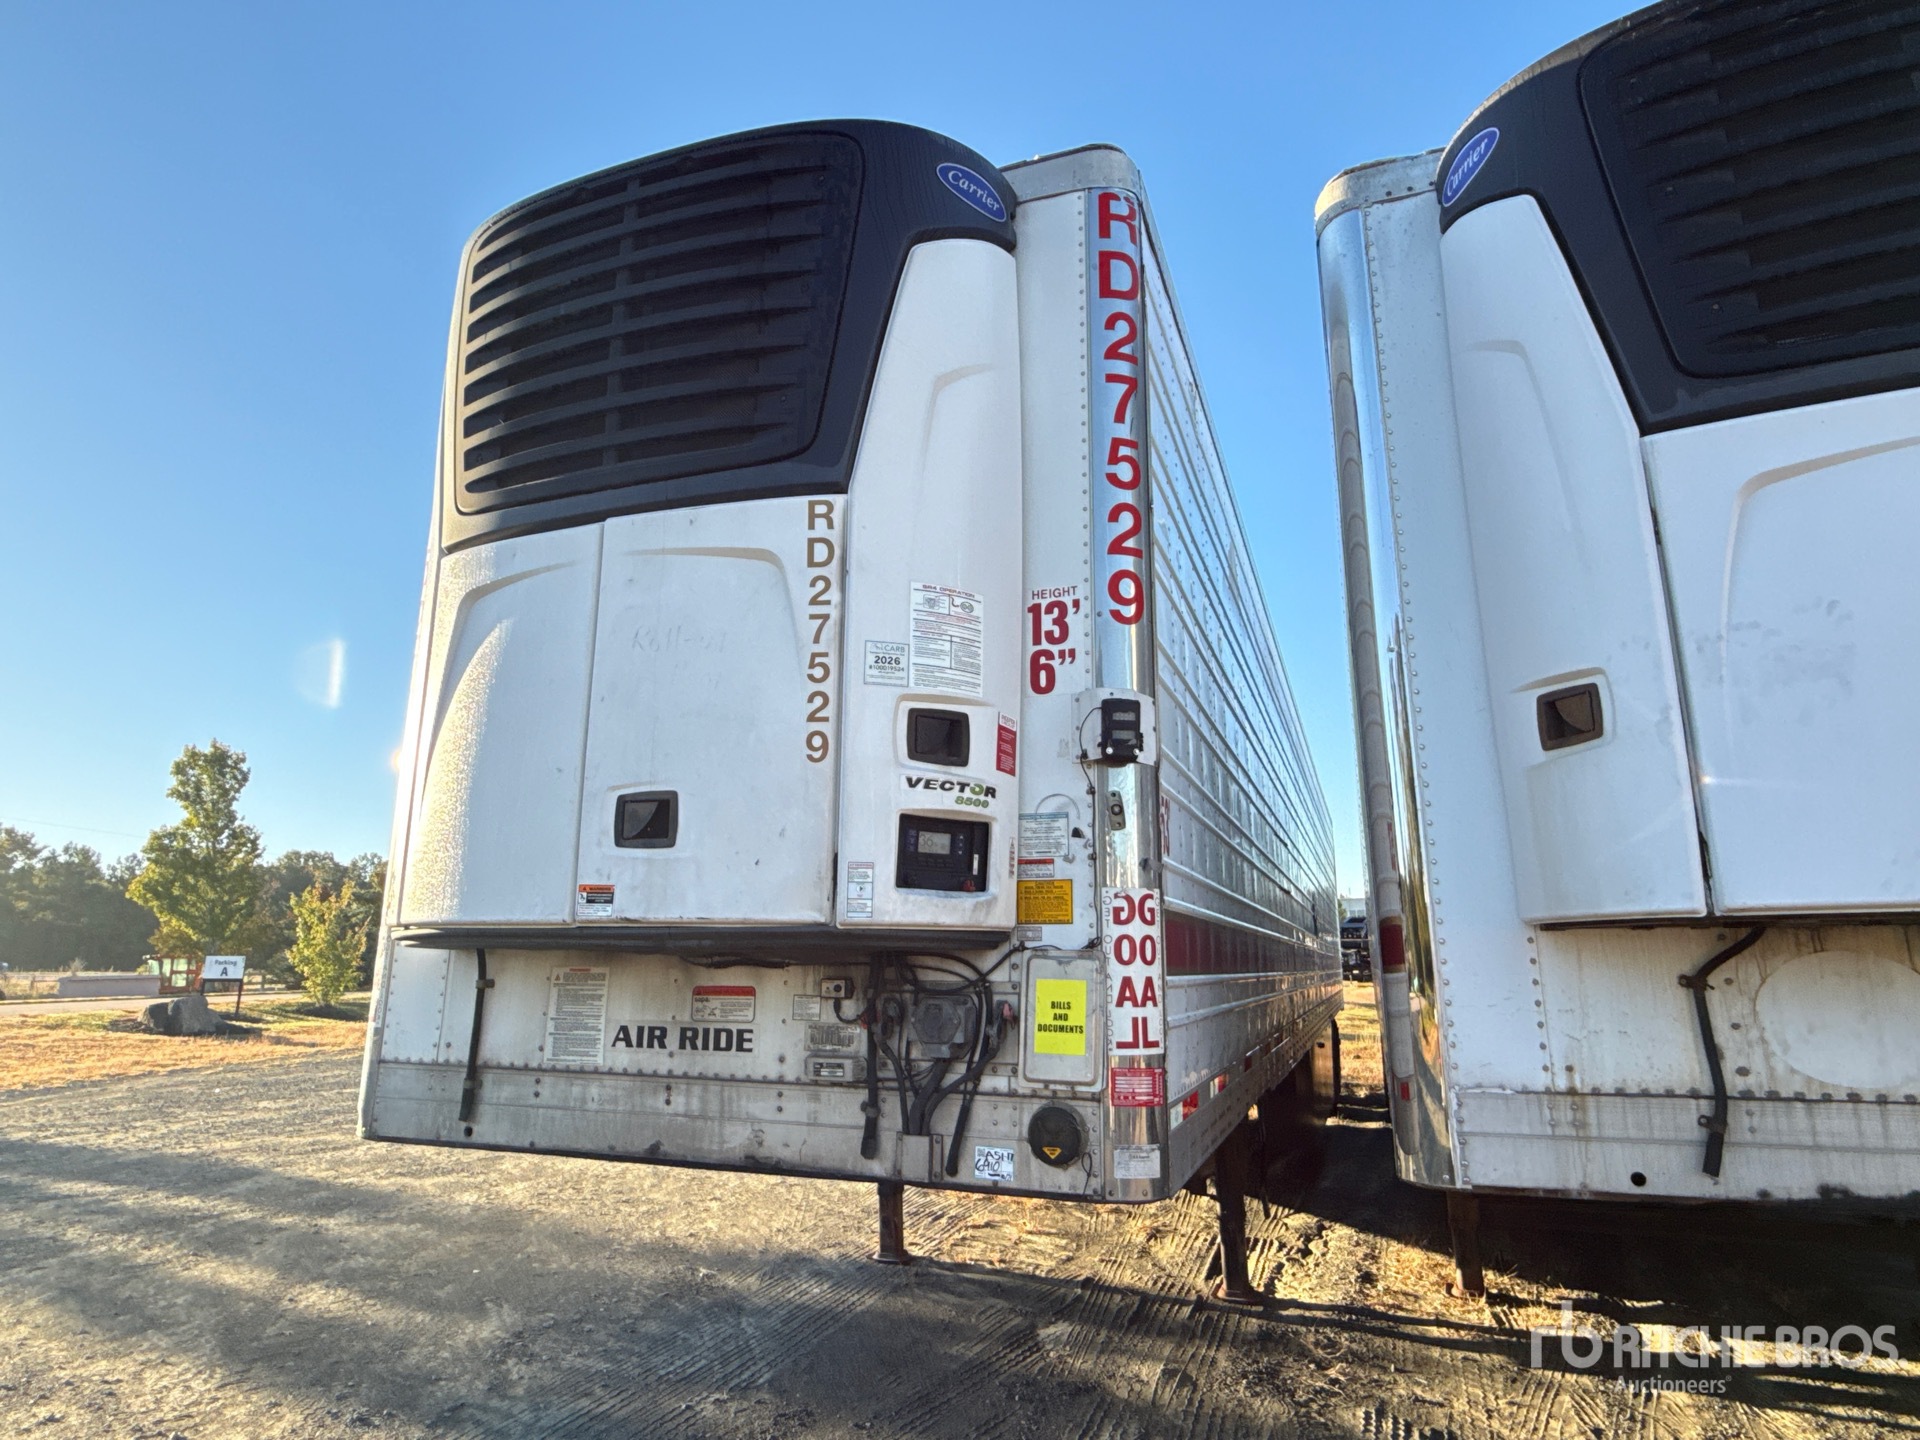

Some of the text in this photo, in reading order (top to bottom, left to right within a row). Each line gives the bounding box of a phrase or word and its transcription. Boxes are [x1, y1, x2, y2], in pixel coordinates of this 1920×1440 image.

[1447, 138, 1488, 197] Carrier
[948, 170, 1000, 211] Carrier
[1031, 586, 1078, 600] HEIGHT
[806, 499, 835, 764] RD27529
[884, 644, 905, 653] CARB
[874, 655, 901, 665] 2026
[905, 776, 996, 799] VECTOR
[214, 959, 238, 967] Parking
[220, 967, 228, 976] A
[1051, 1001, 1072, 1010] BILLS
[1053, 1012, 1069, 1021] AND
[1037, 1024, 1084, 1034] DOCUMENTS
[611, 1025, 754, 1053] AIR RIDE
